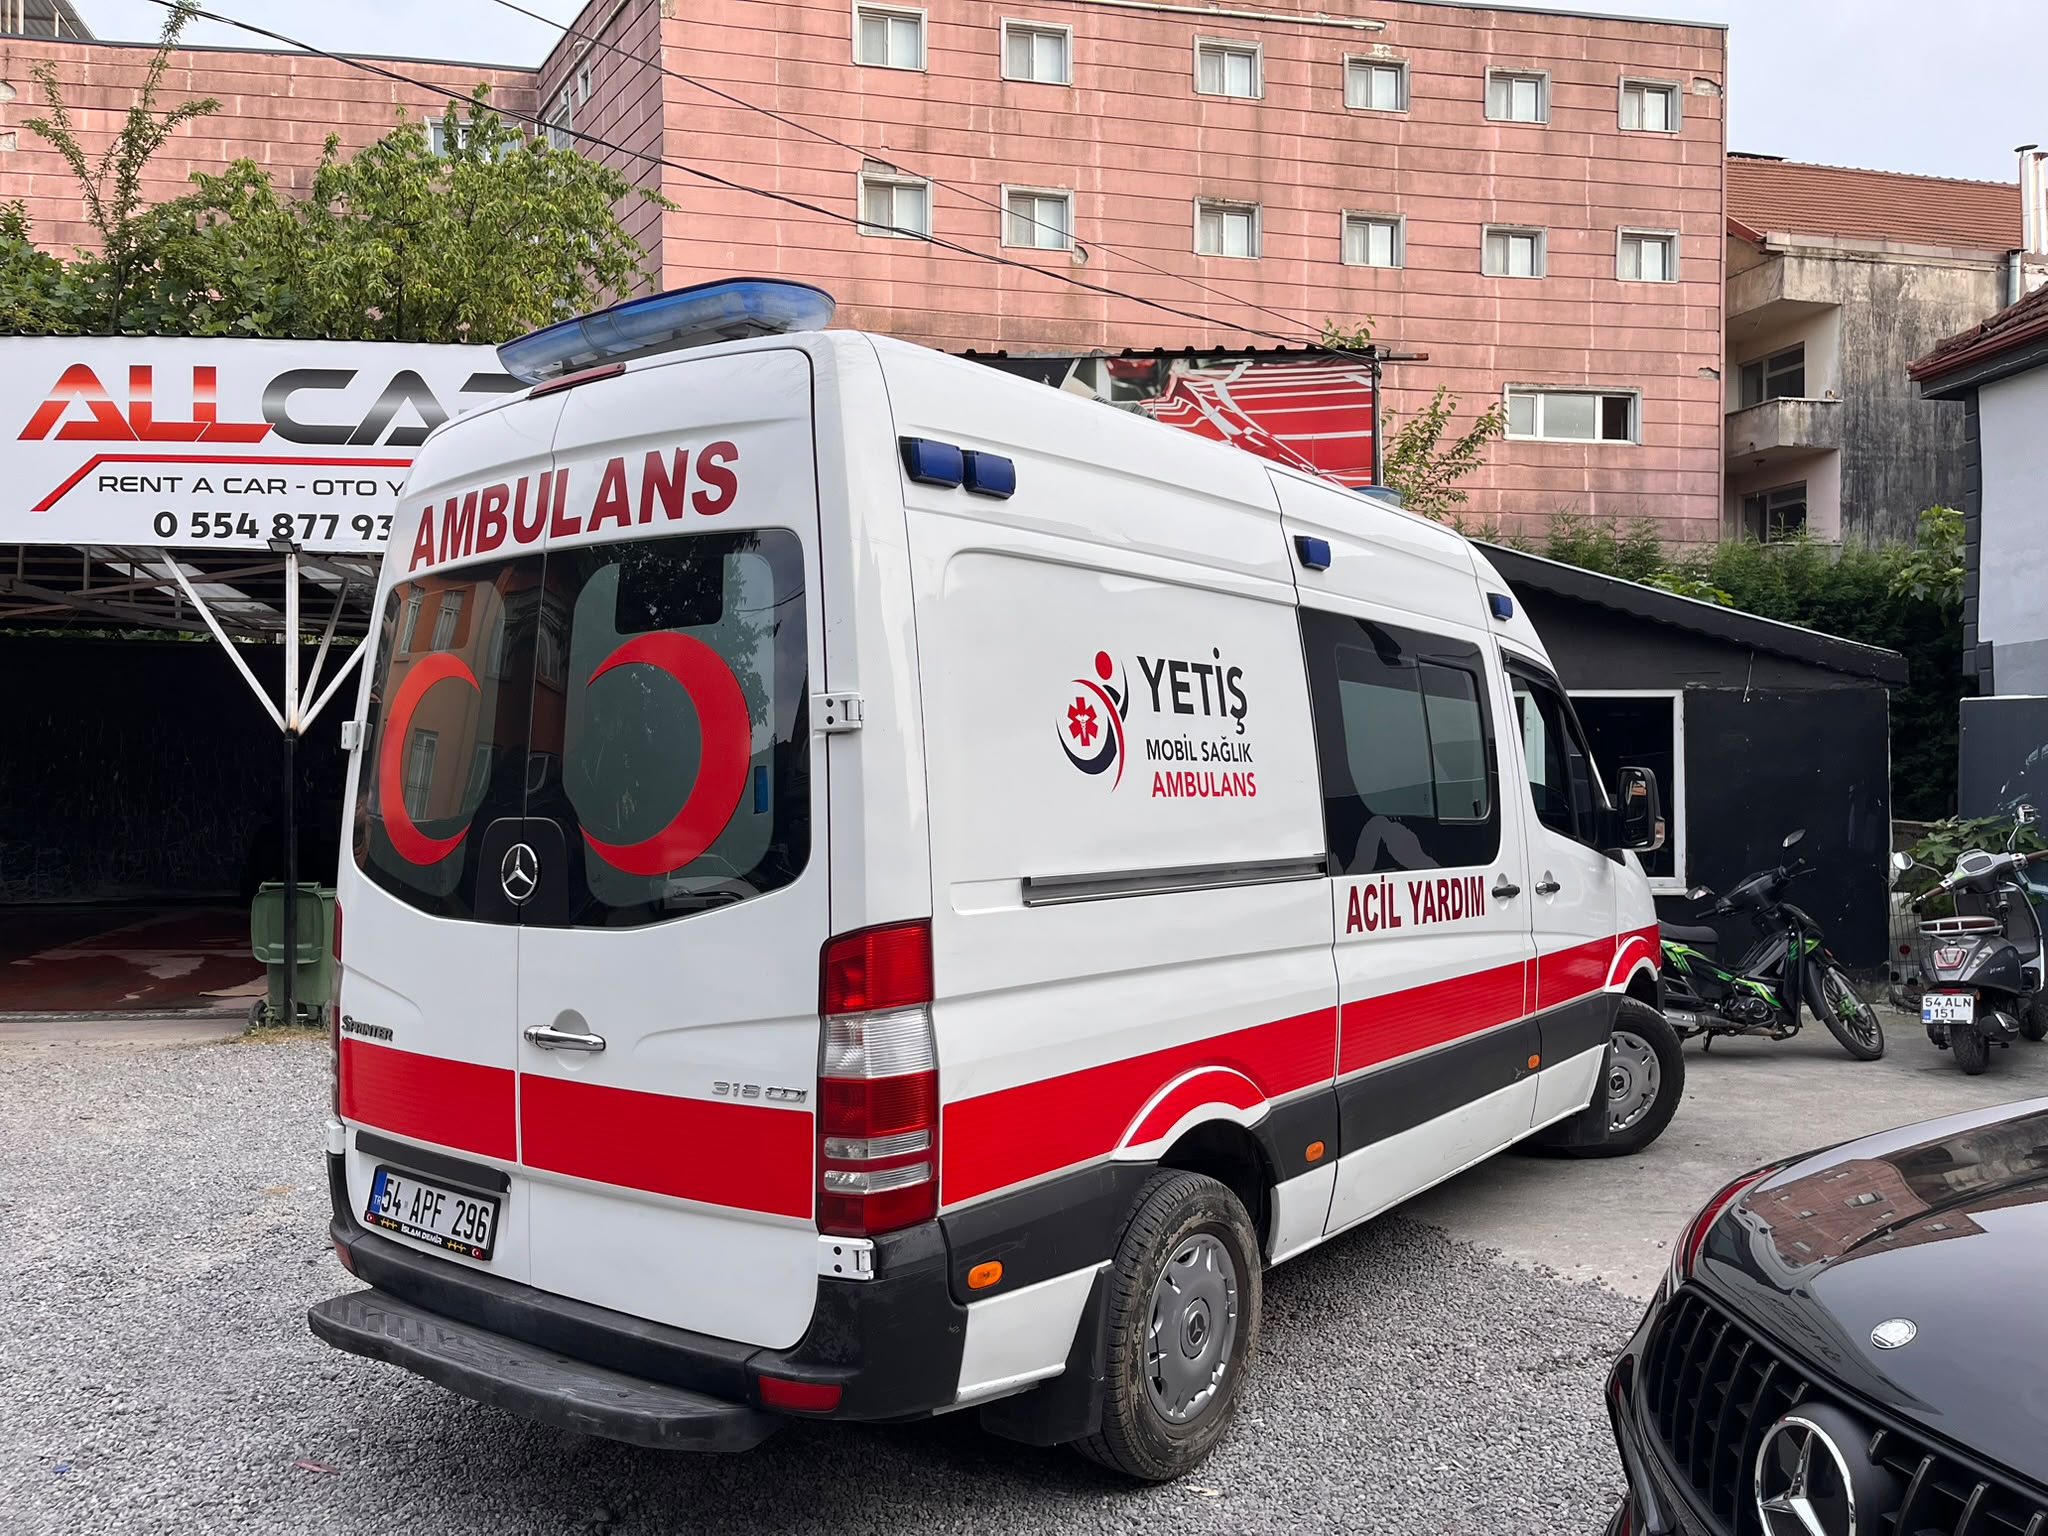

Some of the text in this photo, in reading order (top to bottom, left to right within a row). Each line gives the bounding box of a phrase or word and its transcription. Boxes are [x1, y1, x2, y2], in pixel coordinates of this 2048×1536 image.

[98, 475, 183, 494] RENT
[191, 477, 215, 495] A
[223, 477, 288, 496] CAR
[312, 479, 383, 496] OTO
[408, 440, 739, 573] AMBULANS
[153, 511, 179, 539] 0
[190, 512, 260, 539] 554
[271, 513, 340, 541] 877
[1136, 647, 1248, 735] YETİŞ
[1146, 733, 1254, 763] MOBİL SAĞLIK
[1151, 771, 1257, 798] AMBULANS
[1346, 874, 1486, 934] ACİL YARDIM
[1925, 997, 1972, 1008] 54 ALN
[1934, 1009, 1955, 1019] 151
[381, 1178, 490, 1244] 54 APF 296
